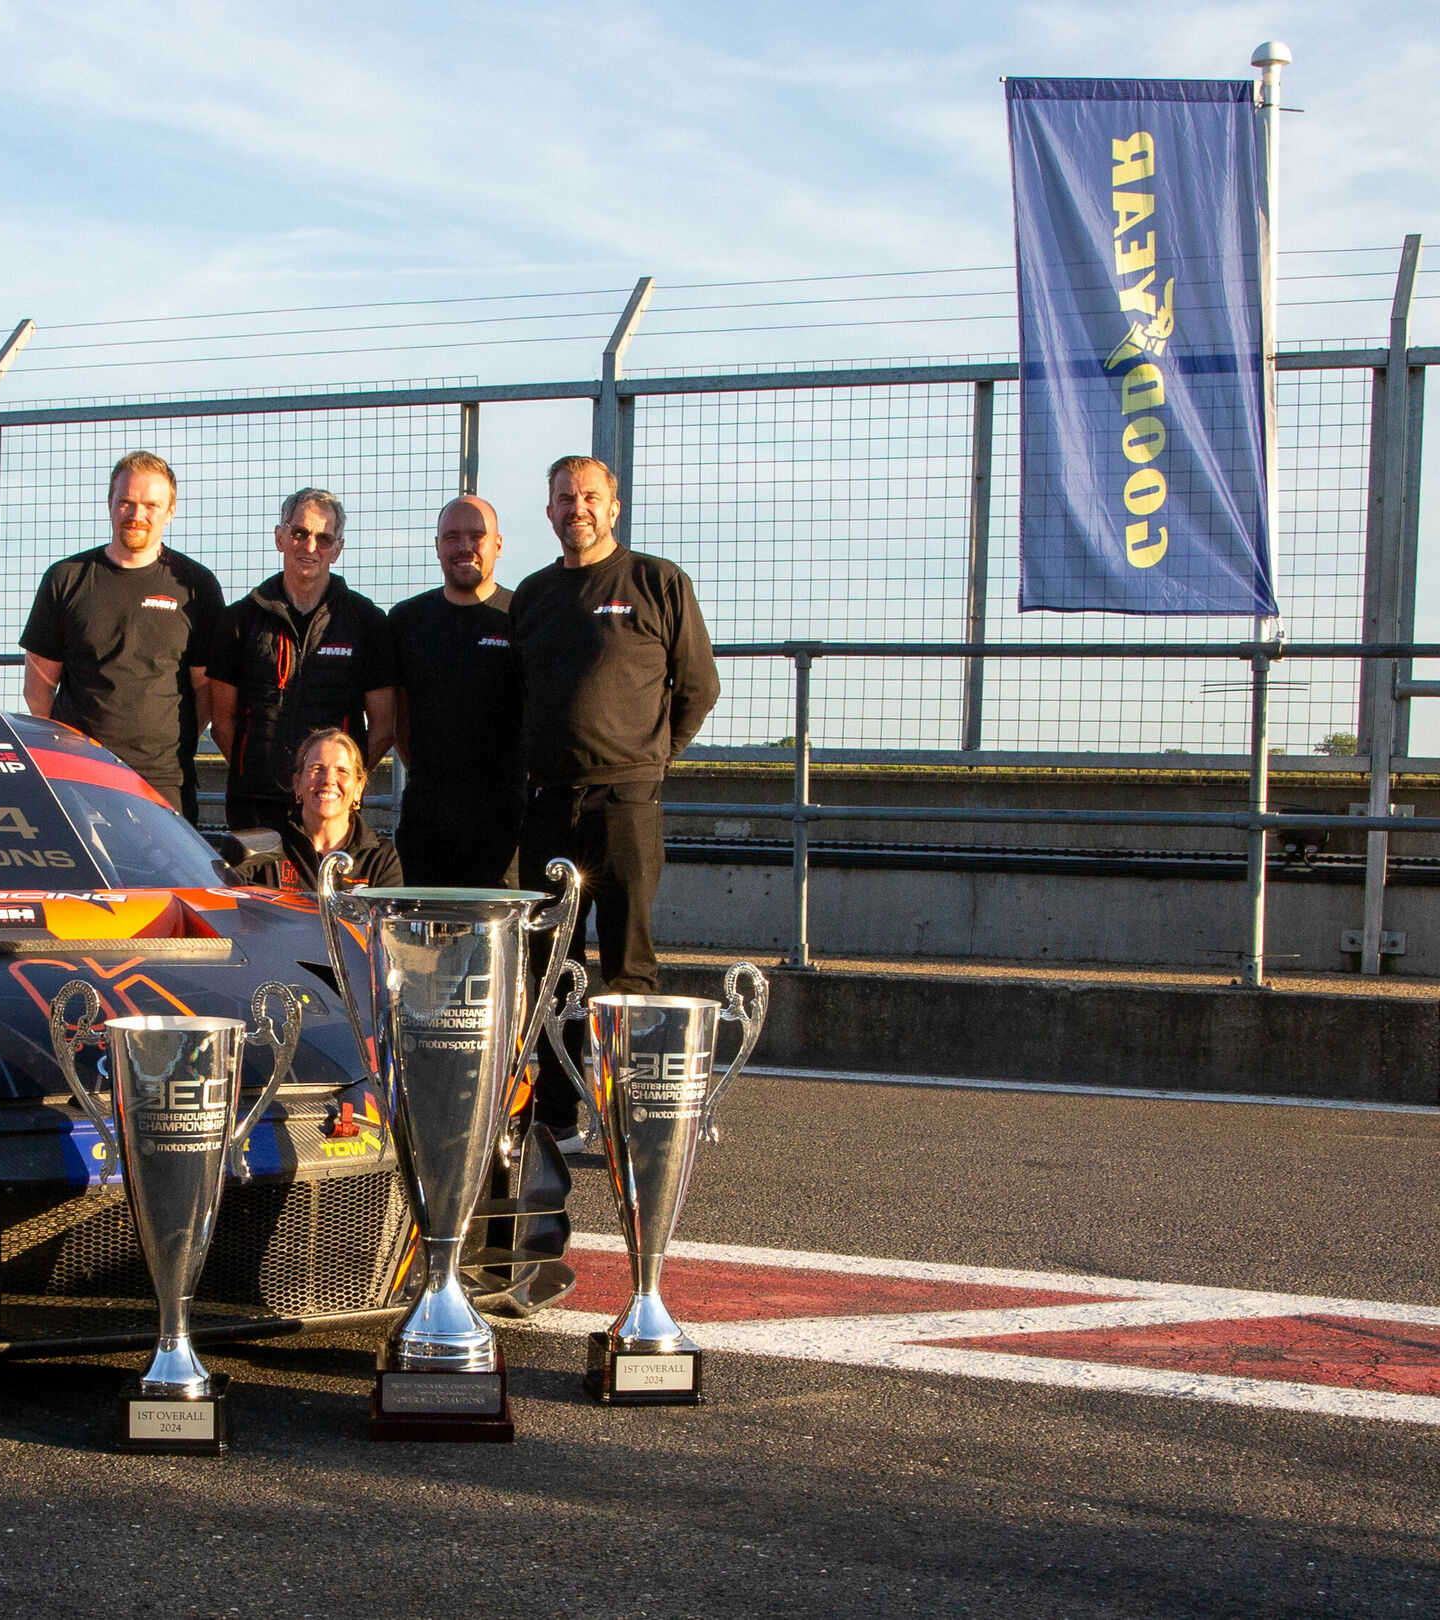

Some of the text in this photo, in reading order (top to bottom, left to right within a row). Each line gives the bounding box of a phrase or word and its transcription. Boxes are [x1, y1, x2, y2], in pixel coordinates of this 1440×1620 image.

[593, 605, 632, 614] JMH
[317, 646, 353, 657] JMH
[418, 1038, 476, 1051] motorsport
[631, 1052, 711, 1080] BEC
[631, 1081, 665, 1091] BRITISH
[140, 1079, 229, 1110] BEC
[631, 1088, 706, 1101] CHAMPIONSHIP
[137, 1110, 226, 1121] BRITISH ENDURANCE
[138, 1119, 225, 1132] CHAMPIONSHIP
[157, 1141, 212, 1153] motorsport
[320, 1142, 366, 1158] TOW
[624, 1364, 686, 1374] 1ST OVERALL
[644, 1375, 664, 1384] 2024
[137, 1411, 206, 1421] 1ST OVERALL
[160, 1423, 182, 1433] 2024
